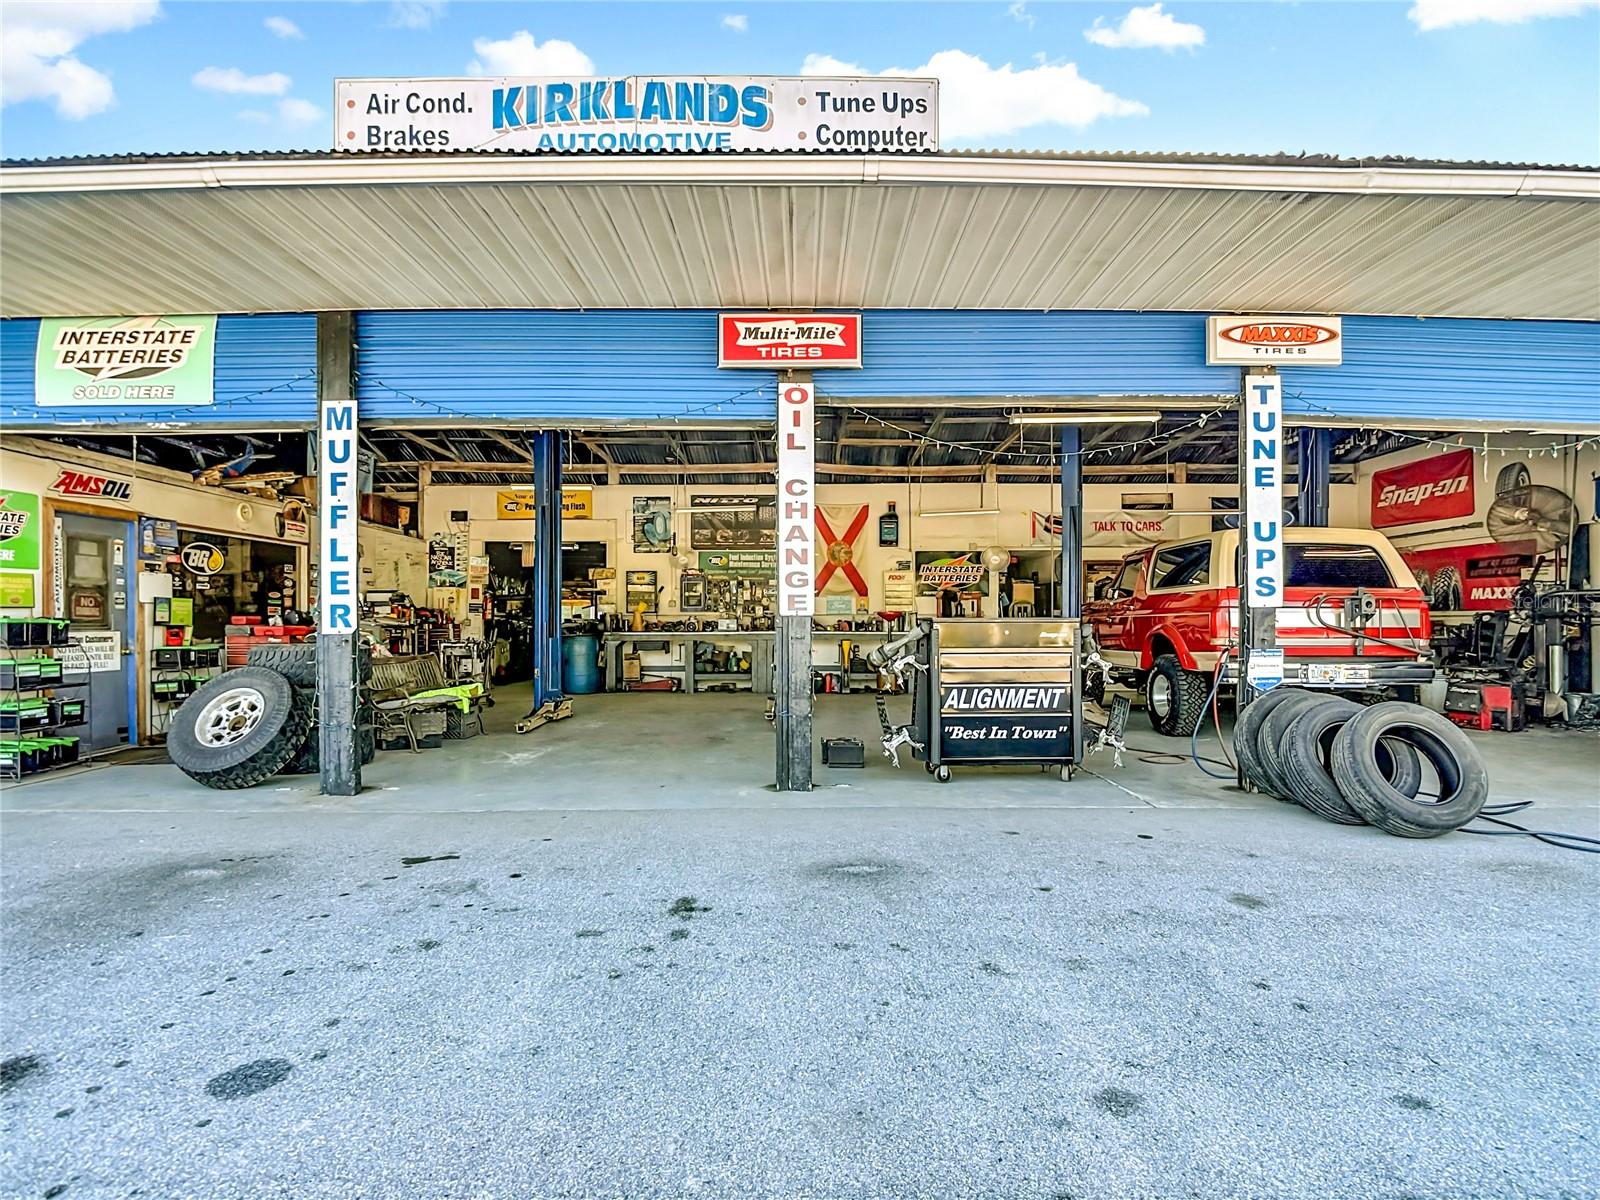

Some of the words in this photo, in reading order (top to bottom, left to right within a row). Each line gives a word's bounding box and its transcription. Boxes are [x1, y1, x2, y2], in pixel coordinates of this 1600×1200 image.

[366, 93, 400, 114] Air
[405, 92, 473, 113] Cond.
[491, 79, 772, 131] KIRKLANDS
[815, 91, 875, 113] Tune
[882, 92, 928, 118] Ups
[366, 125, 450, 146] Brakes
[538, 132, 732, 150] AUTOMOTIVE
[815, 123, 928, 148] Computer
[60, 330, 195, 345] INTERSTATE
[742, 326, 836, 340] Multi-Mile
[1240, 327, 1319, 343] MAXXIS
[62, 349, 183, 364] BATTERIES
[757, 347, 823, 357] TIRES
[73, 386, 121, 399] SOLD
[125, 386, 175, 399] HERE
[784, 387, 809, 450] OIL
[1252, 385, 1276, 487] TUNE
[53, 470, 132, 500] AMSOIL
[1377, 476, 1470, 507] Snap-on
[326, 407, 352, 628] MUFFLER
[1092, 521, 1116, 532] TALK
[1120, 521, 1133, 532] TO
[1135, 521, 1164, 532] CARS.
[784, 479, 809, 611] CHANGE
[188, 550, 209, 567] BG
[1254, 522, 1277, 597] UPS
[81, 597, 95, 607] NO
[1471, 586, 1519, 600] MAXX
[944, 688, 1065, 709] ALIGNMENT
[944, 726, 987, 739] "Best
[989, 727, 1007, 739] In
[1011, 726, 1067, 739] Town"
